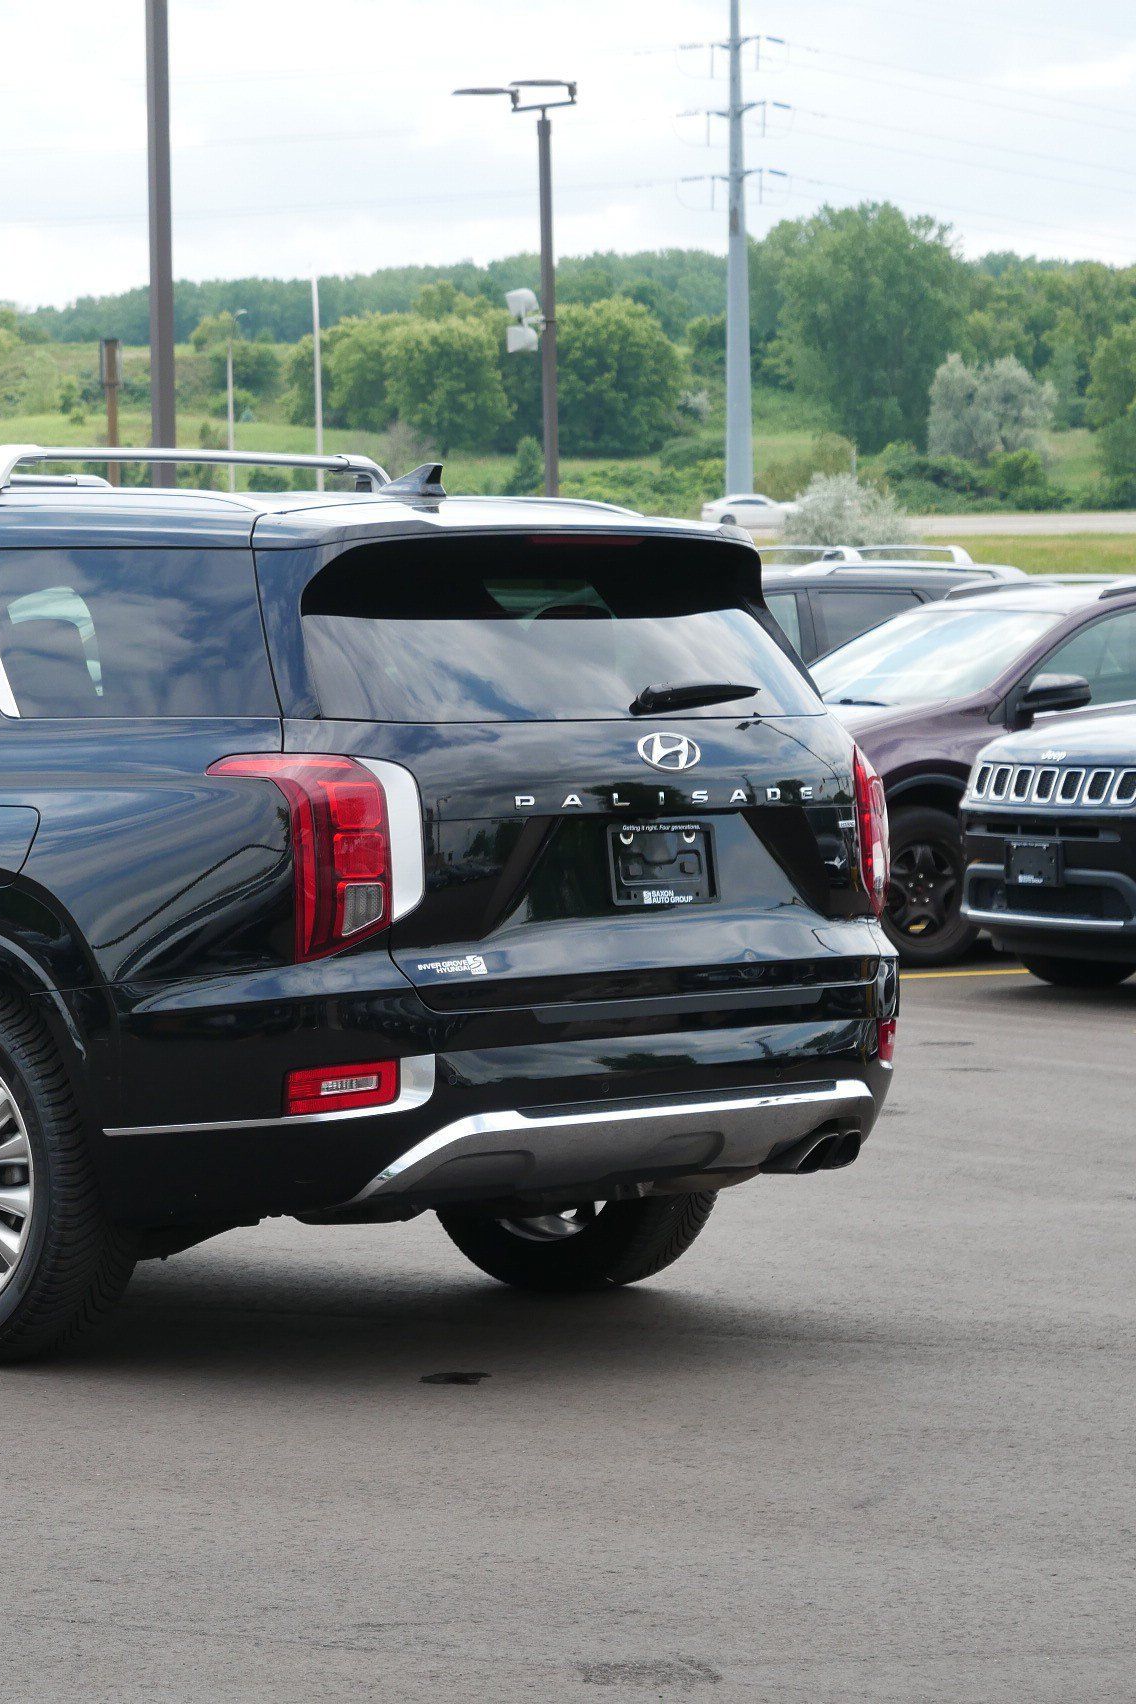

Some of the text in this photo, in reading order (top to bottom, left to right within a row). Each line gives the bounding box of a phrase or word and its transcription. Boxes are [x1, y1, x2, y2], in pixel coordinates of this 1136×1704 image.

[1041, 750, 1067, 761] Jeep
[514, 786, 814, 809] PALISADE
[417, 959, 469, 971] INVER GROVE
[436, 965, 471, 974] HYUNDAI
